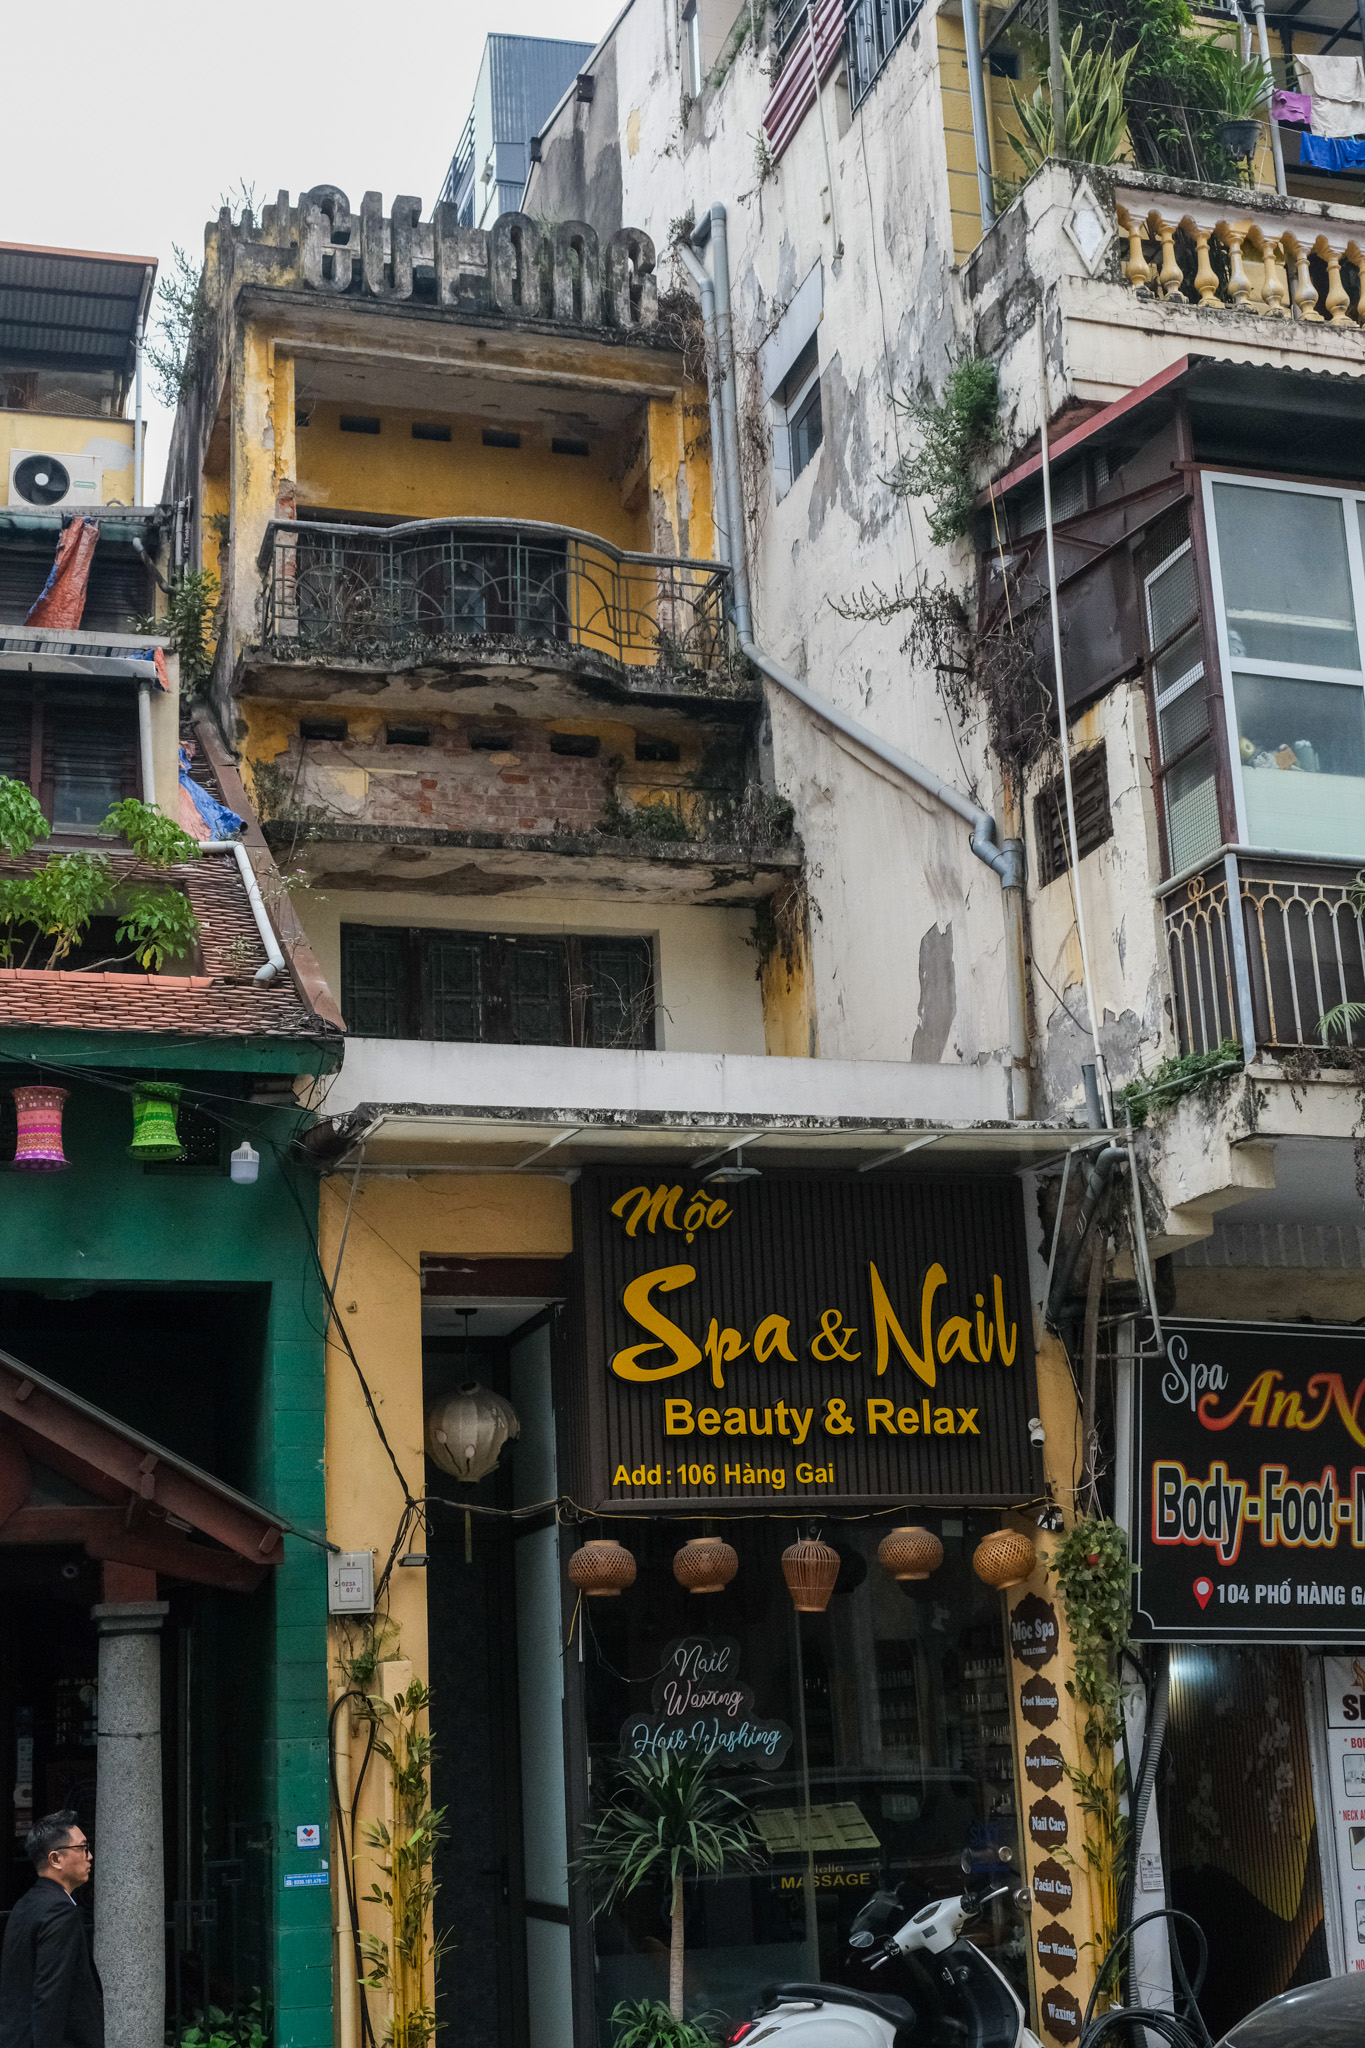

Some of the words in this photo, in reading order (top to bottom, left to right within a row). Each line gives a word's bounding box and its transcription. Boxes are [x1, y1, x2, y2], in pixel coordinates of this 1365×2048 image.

[611, 1184, 733, 1244] Mộc
[611, 1264, 798, 1389] Spa
[810, 1308, 862, 1362] &
[869, 1260, 1017, 1388] Nail
[1161, 1335, 1229, 1412] Spa
[664, 1398, 814, 1444] Beauty
[824, 1397, 855, 1435] &
[866, 1398, 981, 1435] Relax
[677, 1464, 716, 1485] 106
[724, 1464, 786, 1490] Hàng
[795, 1462, 834, 1485] Gai
[1216, 1584, 1249, 1604] 104
[1255, 1578, 1293, 1605] PHỐ
[1297, 1581, 1345, 1605] HÀNG
[1351, 1585, 1365, 1606] G
[1034, 1618, 1055, 1642] Spa
[674, 1645, 731, 1681] Nail
[1021, 1646, 1047, 1656] WELCOME
[663, 1680, 744, 1716] Waxing
[1021, 1695, 1034, 1706] Foot
[1035, 1695, 1058, 1708] Massage
[689, 1717, 783, 1755] Washing
[1025, 1755, 1040, 1768] Body
[1032, 1816, 1047, 1831] Nail
[1048, 1816, 1066, 1832] Care
[1342, 1810, 1358, 1820] NECK
[1034, 1877, 1055, 1893] Facial
[1055, 1880, 1072, 1896] Care
[1038, 1941, 1051, 1953] Hair
[1052, 1943, 1077, 1960] Washing
[1047, 2003, 1076, 2026] Waxing
